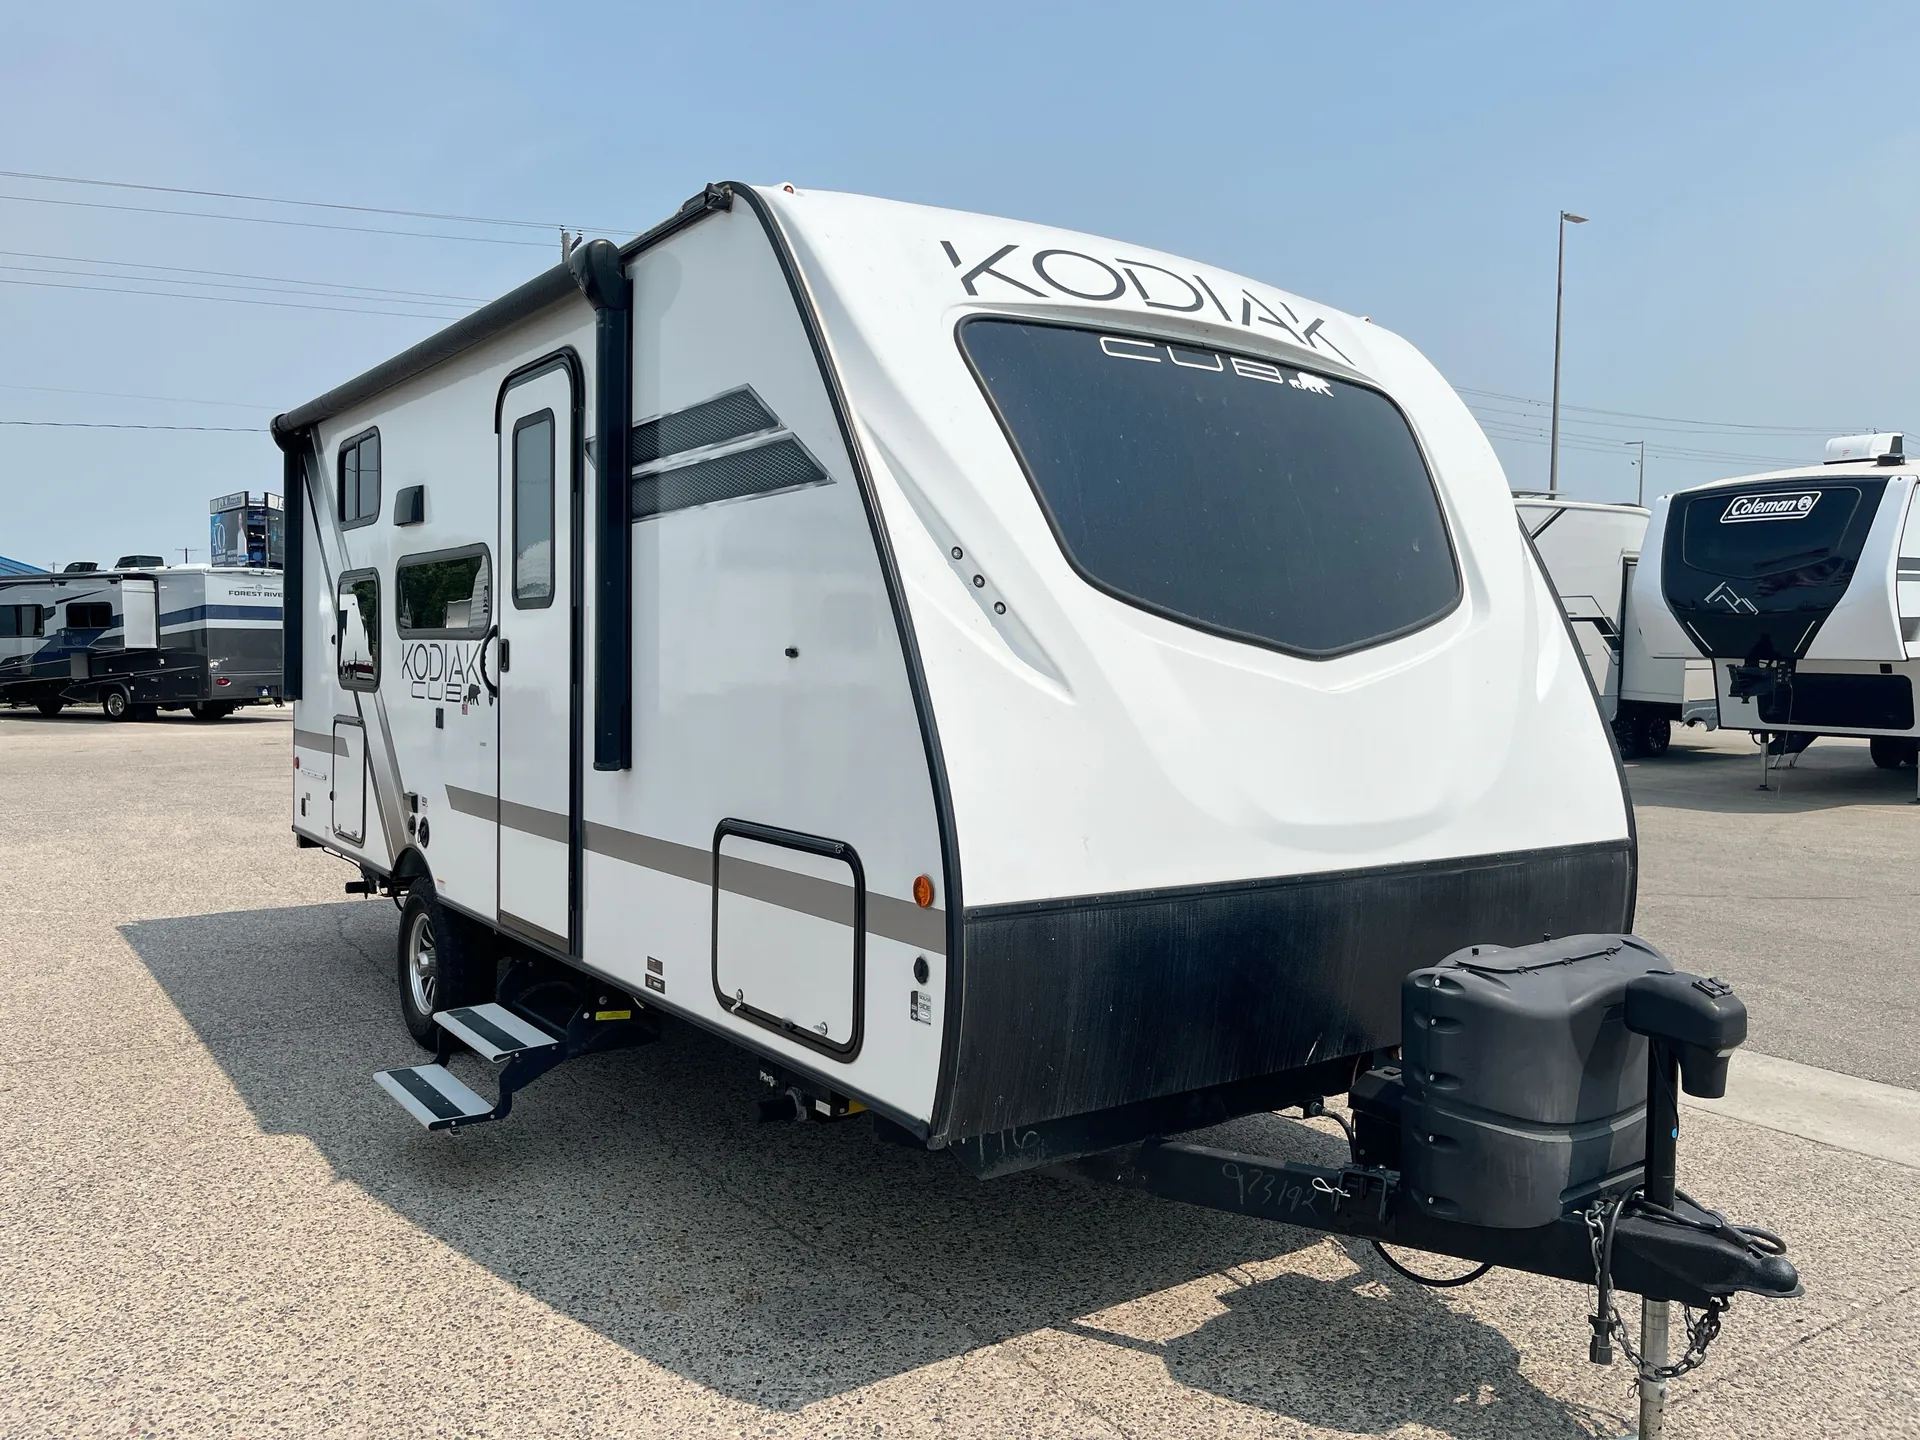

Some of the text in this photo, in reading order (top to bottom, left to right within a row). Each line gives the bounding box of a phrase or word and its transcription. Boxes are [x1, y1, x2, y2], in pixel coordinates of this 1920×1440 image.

[940, 240, 1356, 367] KODIAK
[1099, 342, 1283, 385] CUB
[1731, 498, 1797, 515] Coleman
[402, 643, 481, 685] KODIAK
[411, 680, 462, 703] CUB
